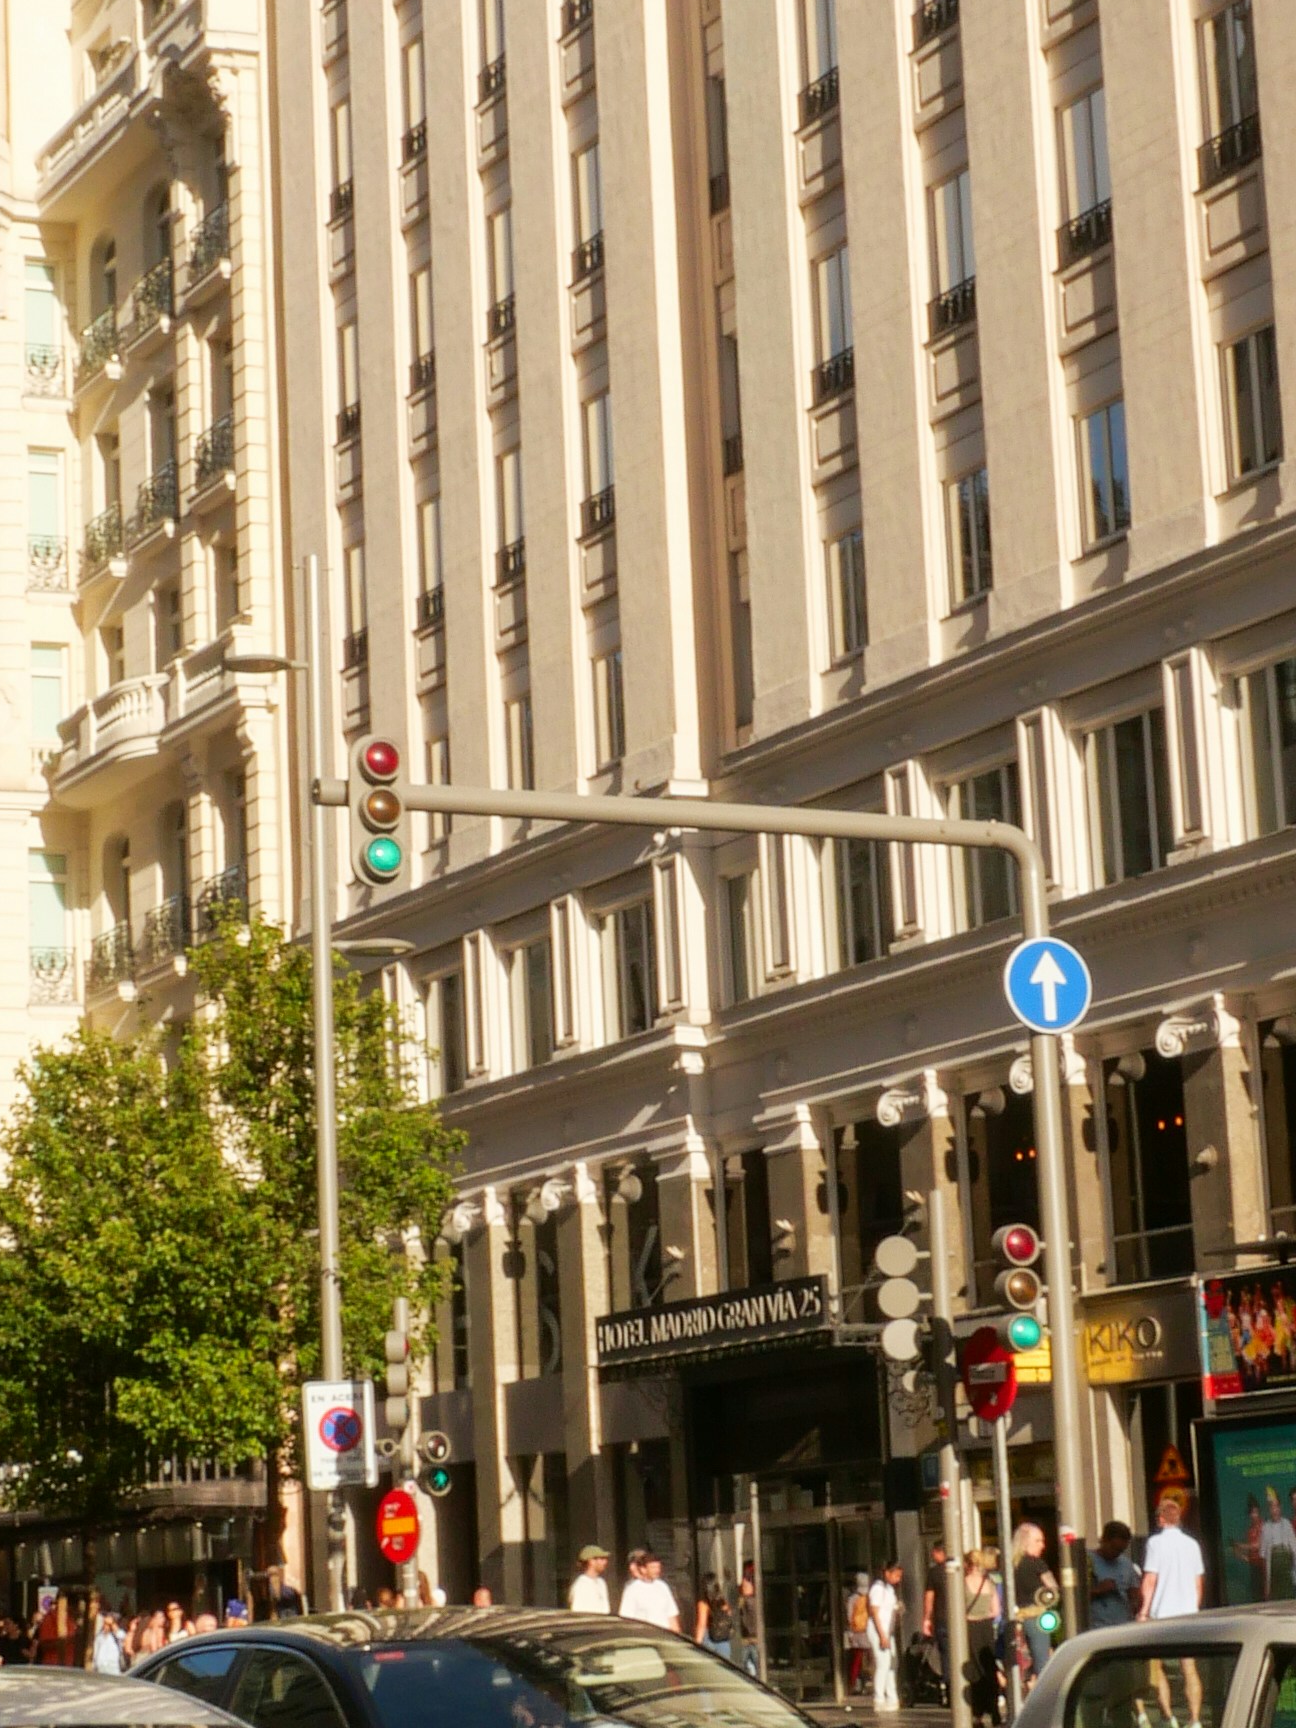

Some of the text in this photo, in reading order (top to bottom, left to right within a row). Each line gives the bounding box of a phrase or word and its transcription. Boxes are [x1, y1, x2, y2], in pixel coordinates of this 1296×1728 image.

[598, 1317, 649, 1353] HOTEL
[650, 1305, 716, 1346] MADRID
[717, 1294, 764, 1333] GRAN
[799, 1285, 822, 1320] 25
[1089, 1316, 1162, 1356] KIKO
